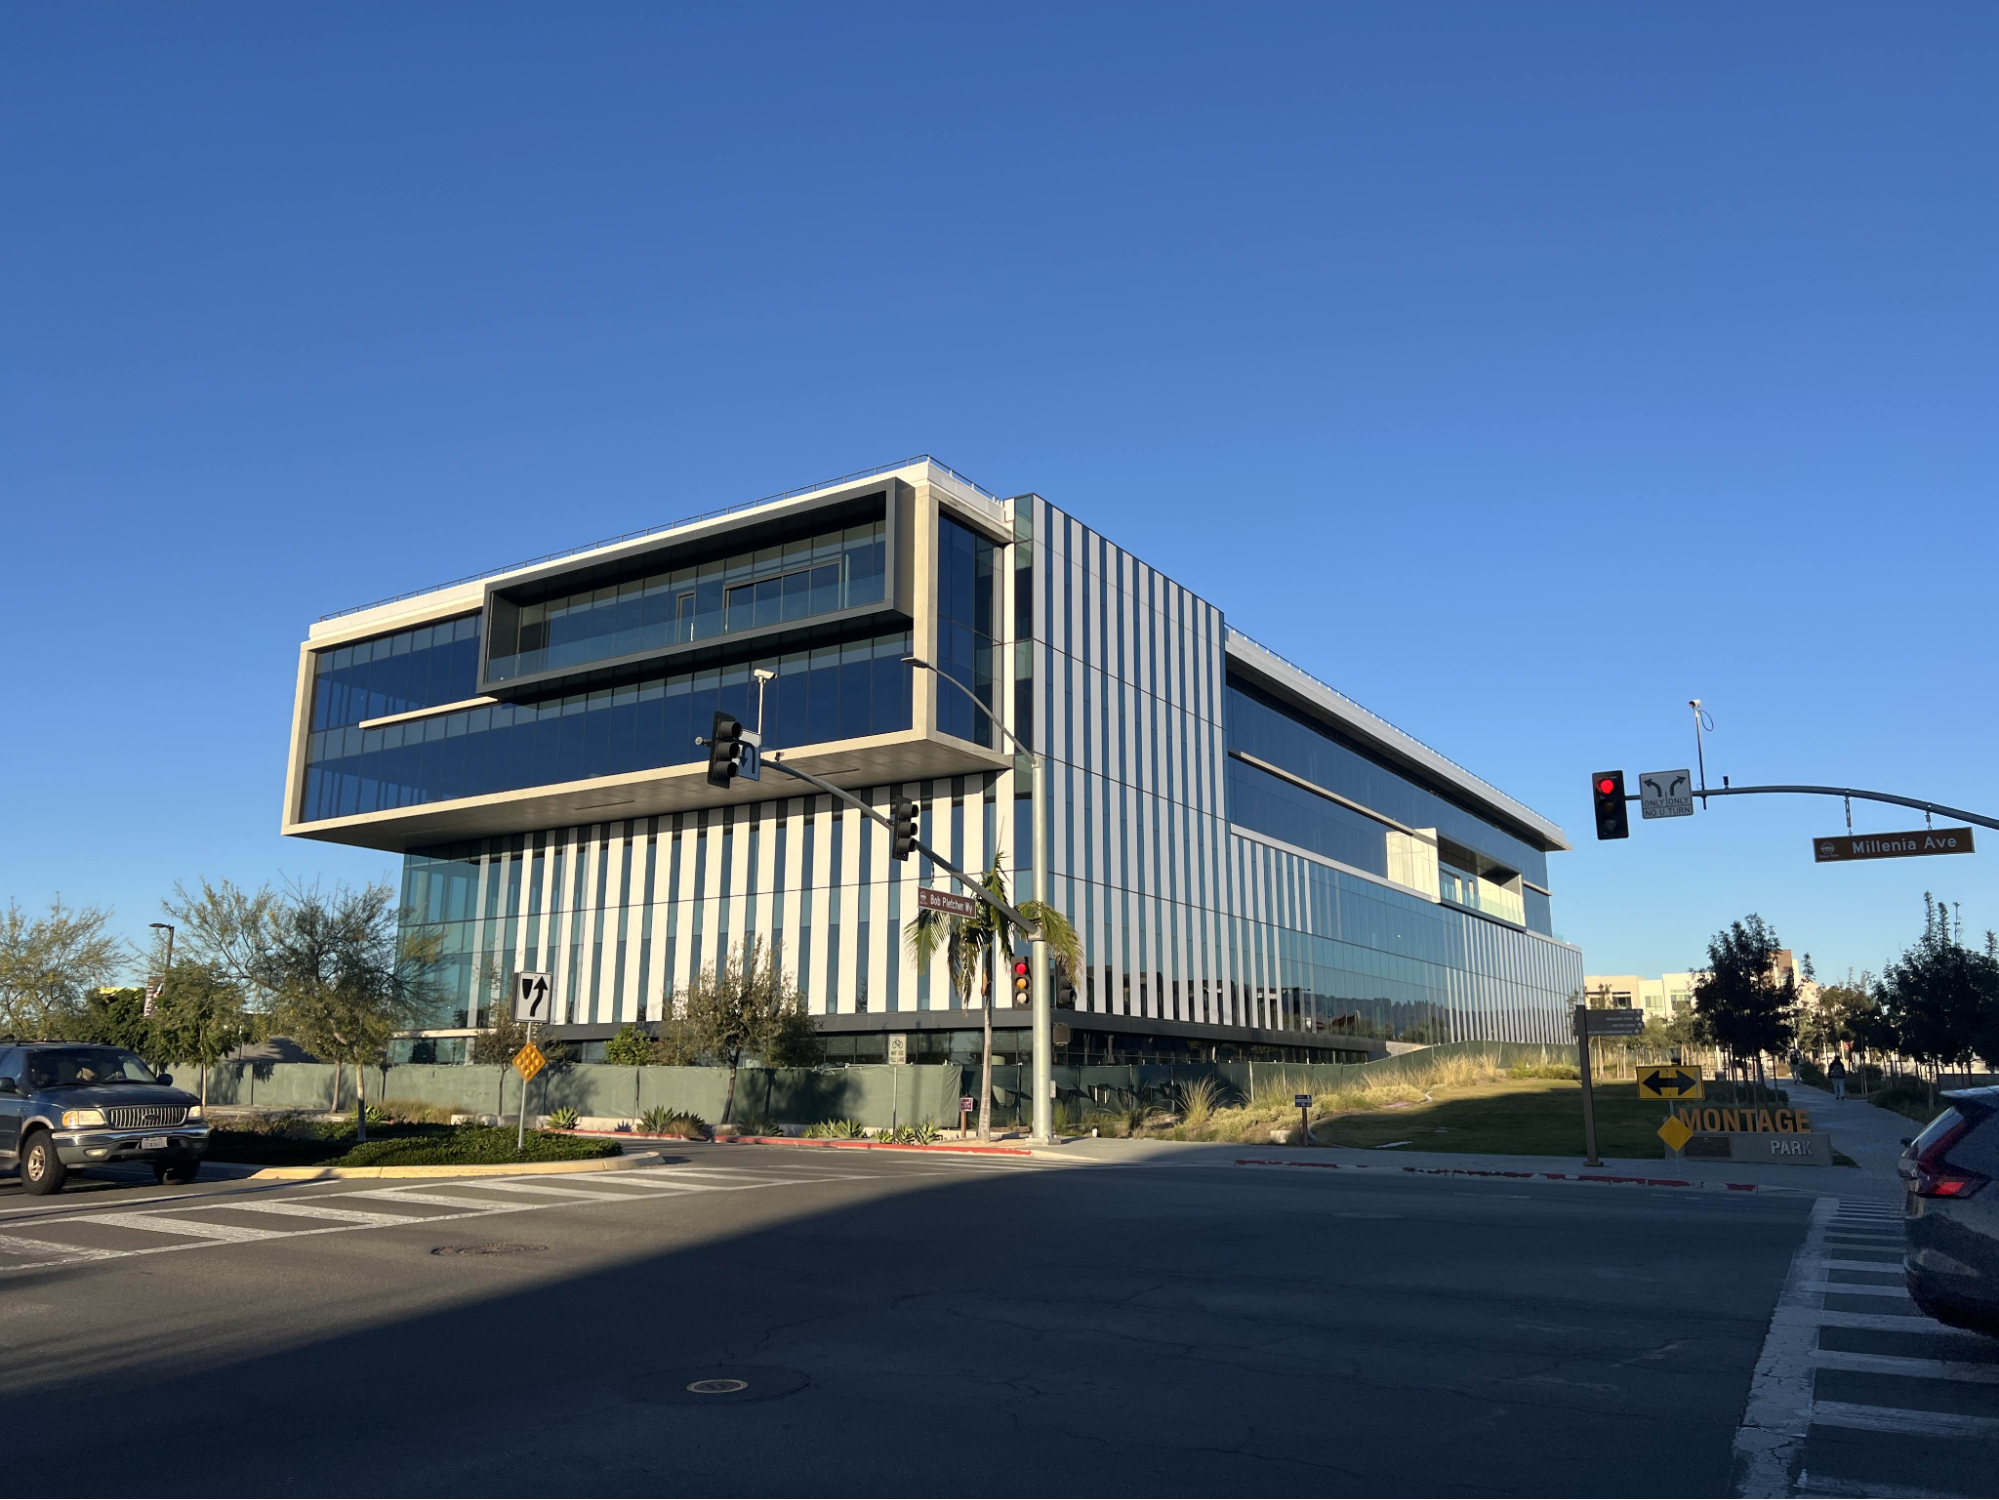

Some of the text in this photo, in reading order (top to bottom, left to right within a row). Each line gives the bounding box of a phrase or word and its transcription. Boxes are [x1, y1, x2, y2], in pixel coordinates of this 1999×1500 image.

[1644, 798, 1664, 806] ONLY
[1668, 796, 1688, 804] ONLY
[1645, 806, 1690, 816] NO U TURN
[1852, 836, 1957, 854] Millenia Ave
[930, 893, 972, 914] Bob Pletcher Wy
[1678, 1107, 1812, 1134] MONTAGE
[1770, 1140, 1814, 1155] PARK
